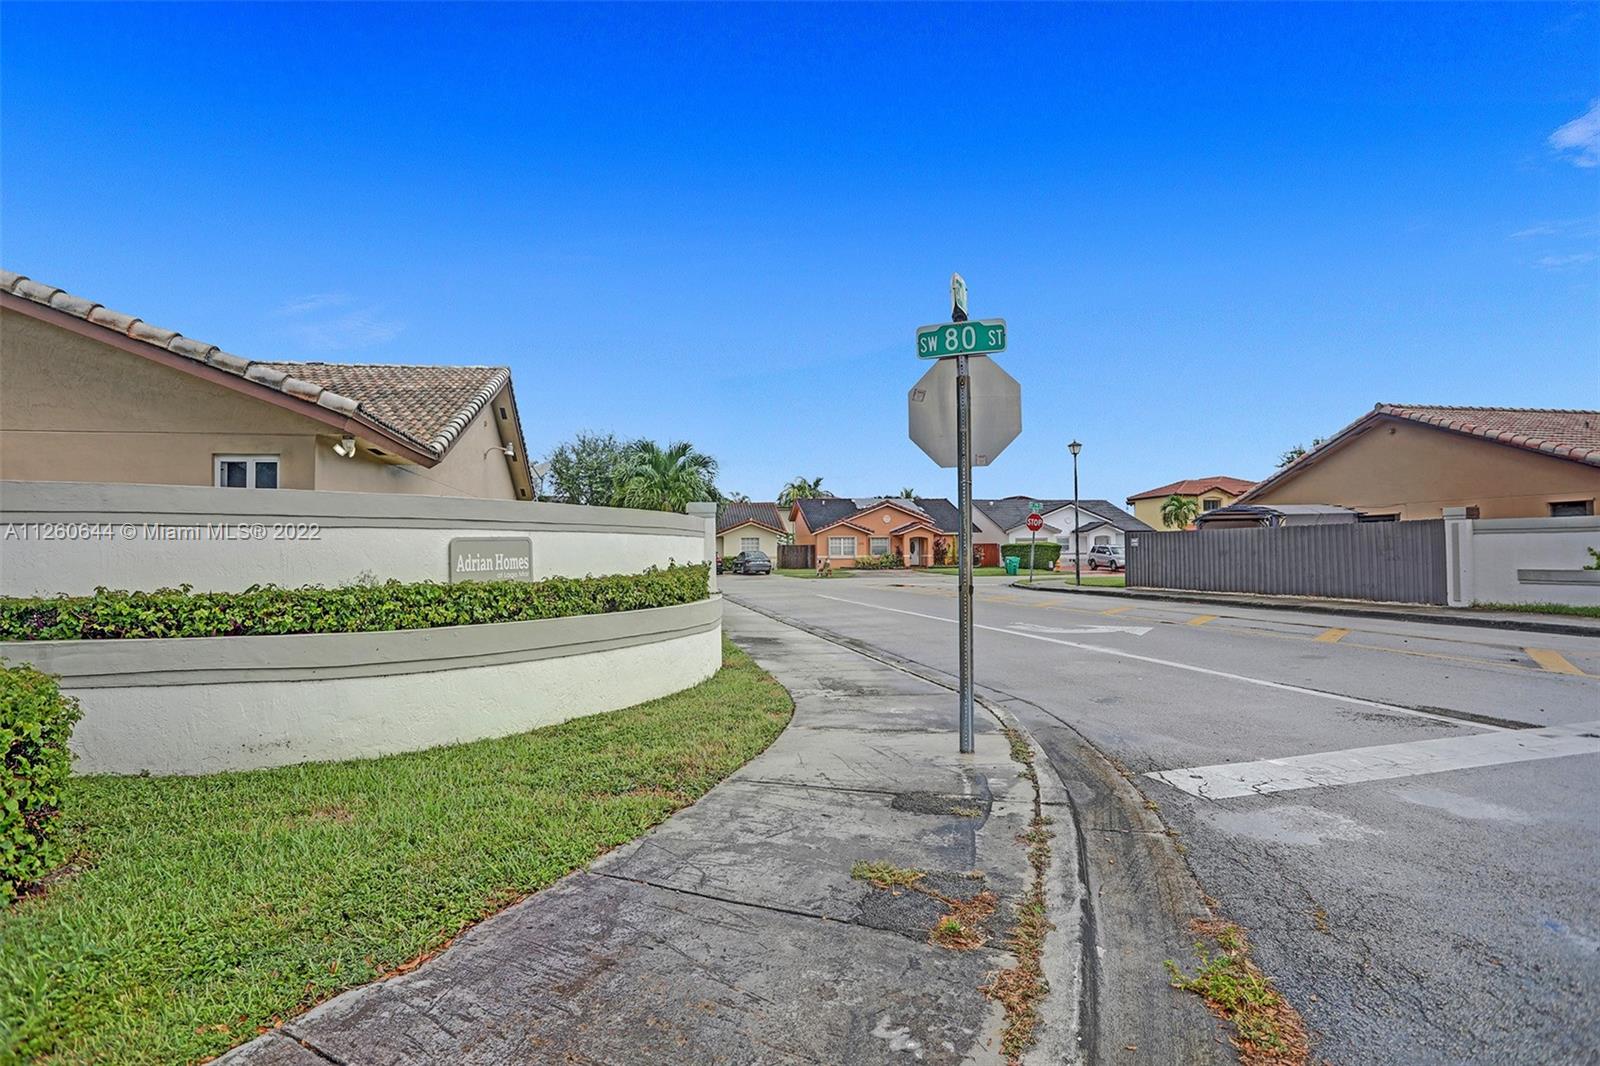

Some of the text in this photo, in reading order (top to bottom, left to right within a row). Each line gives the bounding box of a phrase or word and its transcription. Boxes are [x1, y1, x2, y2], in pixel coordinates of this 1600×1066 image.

[920, 327, 1003, 353] SW 80 ST
[1027, 518, 1043, 526] STOP
[457, 553, 529, 572] Adrian Homes
